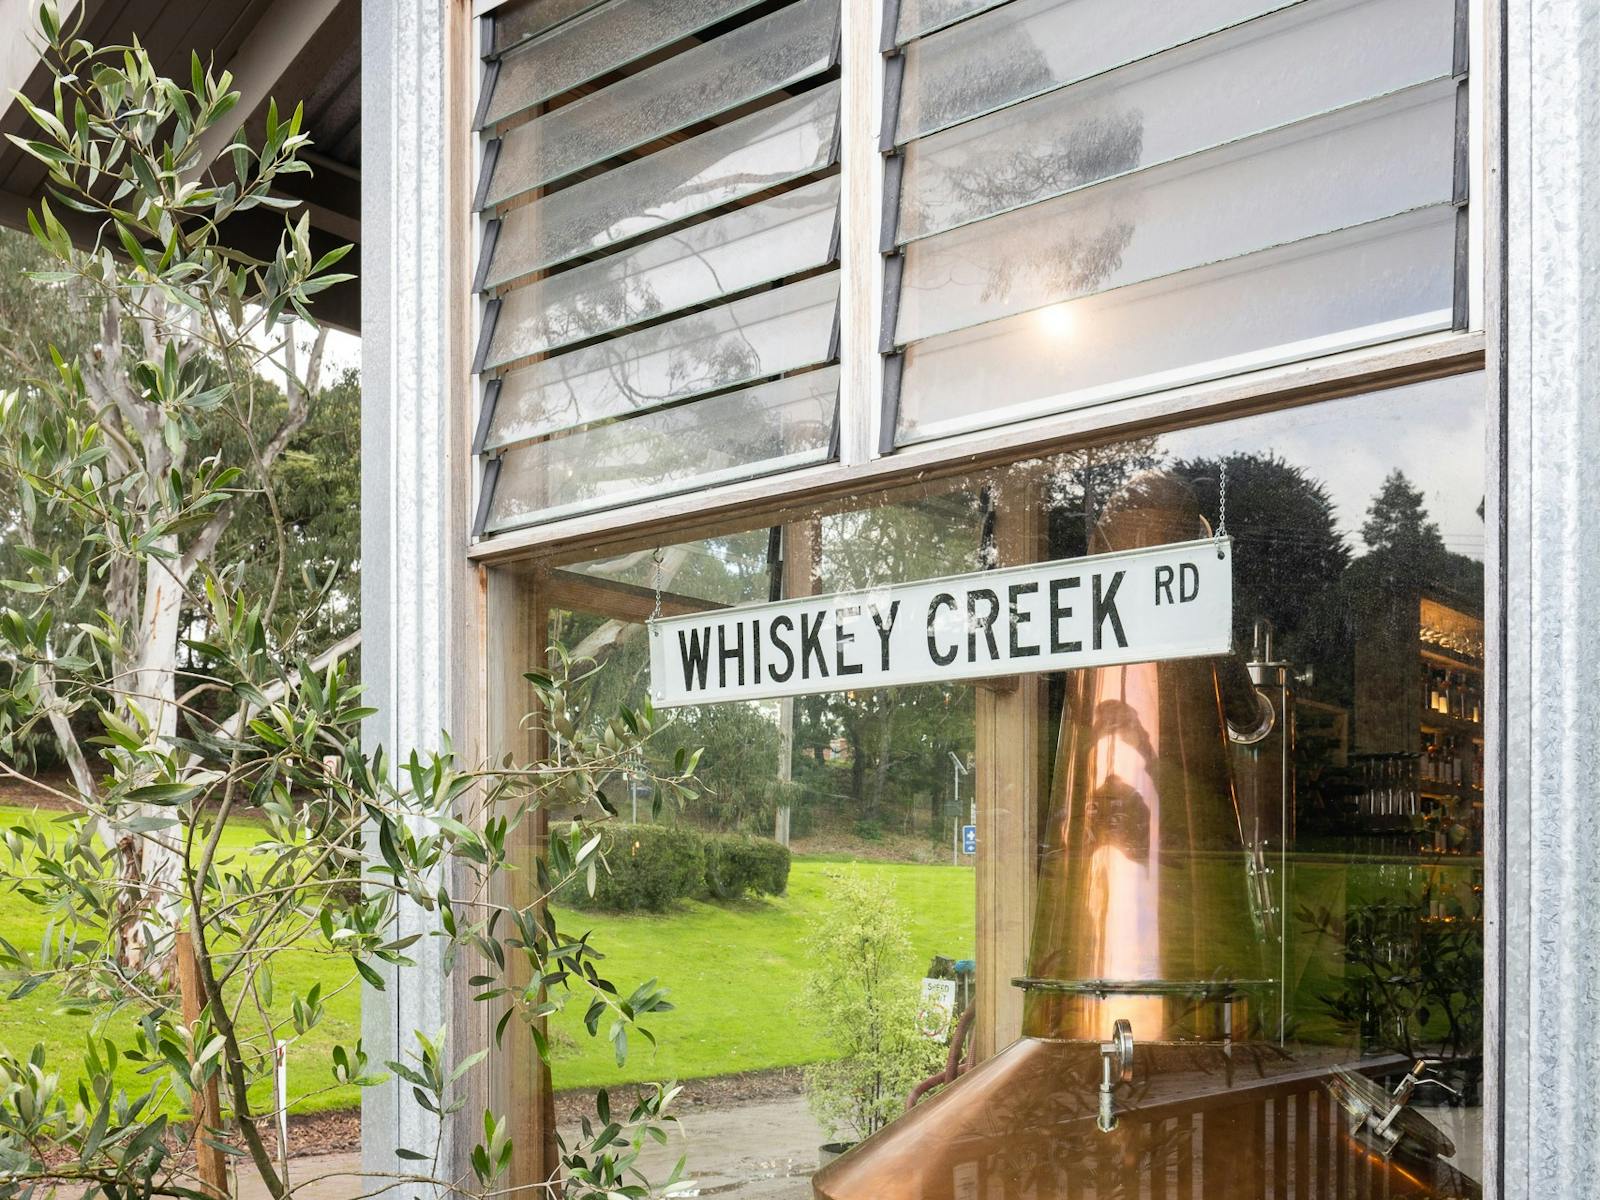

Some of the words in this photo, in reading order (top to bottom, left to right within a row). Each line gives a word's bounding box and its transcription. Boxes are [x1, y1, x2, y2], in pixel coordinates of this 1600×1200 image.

[678, 600, 900, 691] WHISKEY
[926, 570, 1129, 666] CREEK
[1155, 562, 1200, 605] RD
